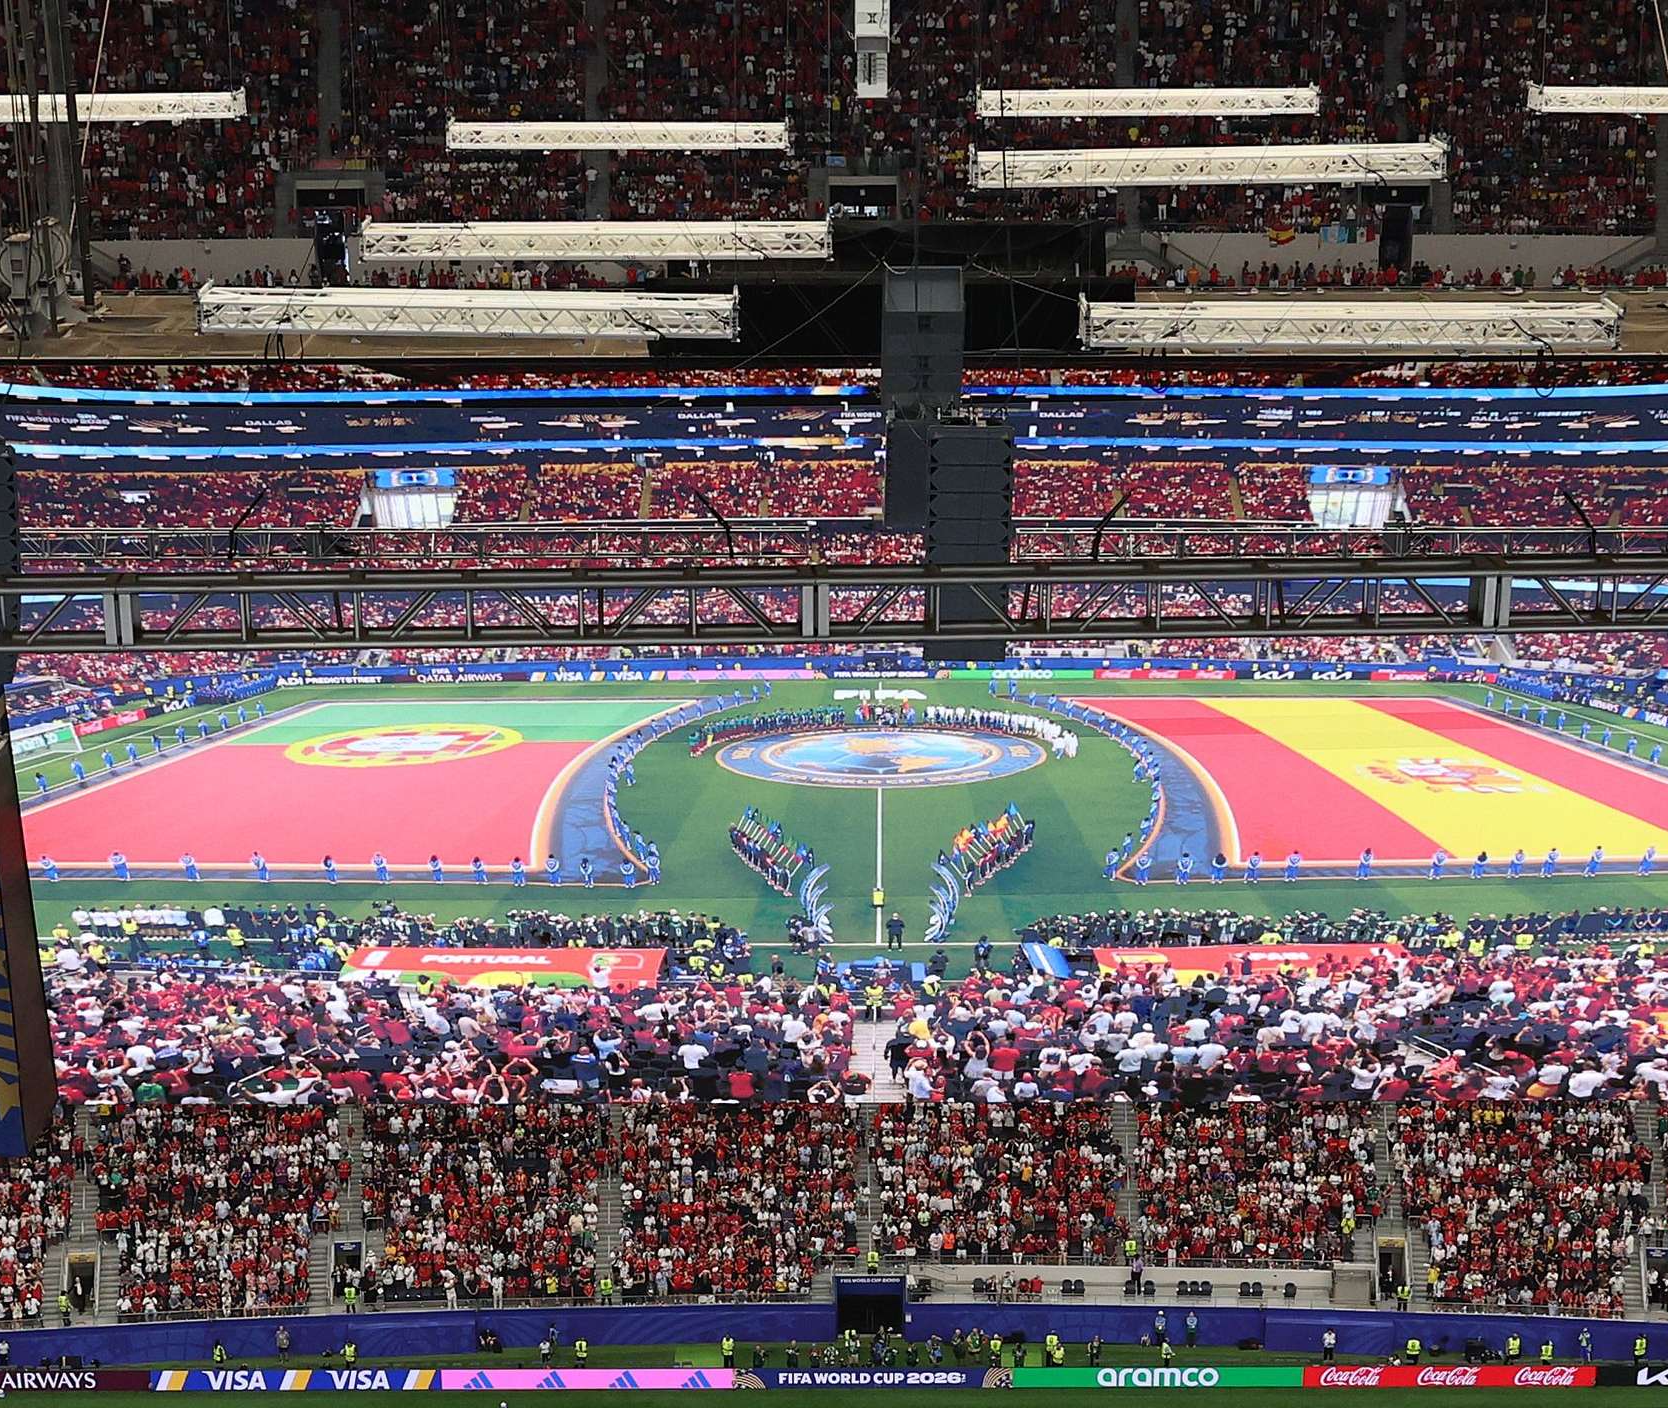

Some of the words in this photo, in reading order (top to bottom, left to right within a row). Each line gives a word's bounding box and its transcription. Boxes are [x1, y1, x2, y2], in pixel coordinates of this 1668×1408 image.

[277, 676, 304, 687] ADI
[417, 674, 454, 684] QATAR
[456, 672, 503, 684] AIRWAYS
[553, 671, 584, 681] VISA
[612, 671, 644, 681] VISA
[421, 954, 551, 965] PORTUGAL
[0, 1371, 97, 1391] AIRWAYS
[201, 1369, 267, 1391] VISA
[325, 1369, 391, 1391] VISA
[778, 1372, 812, 1385] FIFA
[813, 1372, 871, 1385] WORLD
[873, 1372, 905, 1385] CUP
[1096, 1367, 1219, 1387] aramco
[1320, 1366, 1384, 1387] Coca-Cola
[1417, 1366, 1481, 1387] Coca-Cola
[1514, 1366, 1579, 1387] Coca-Cola
